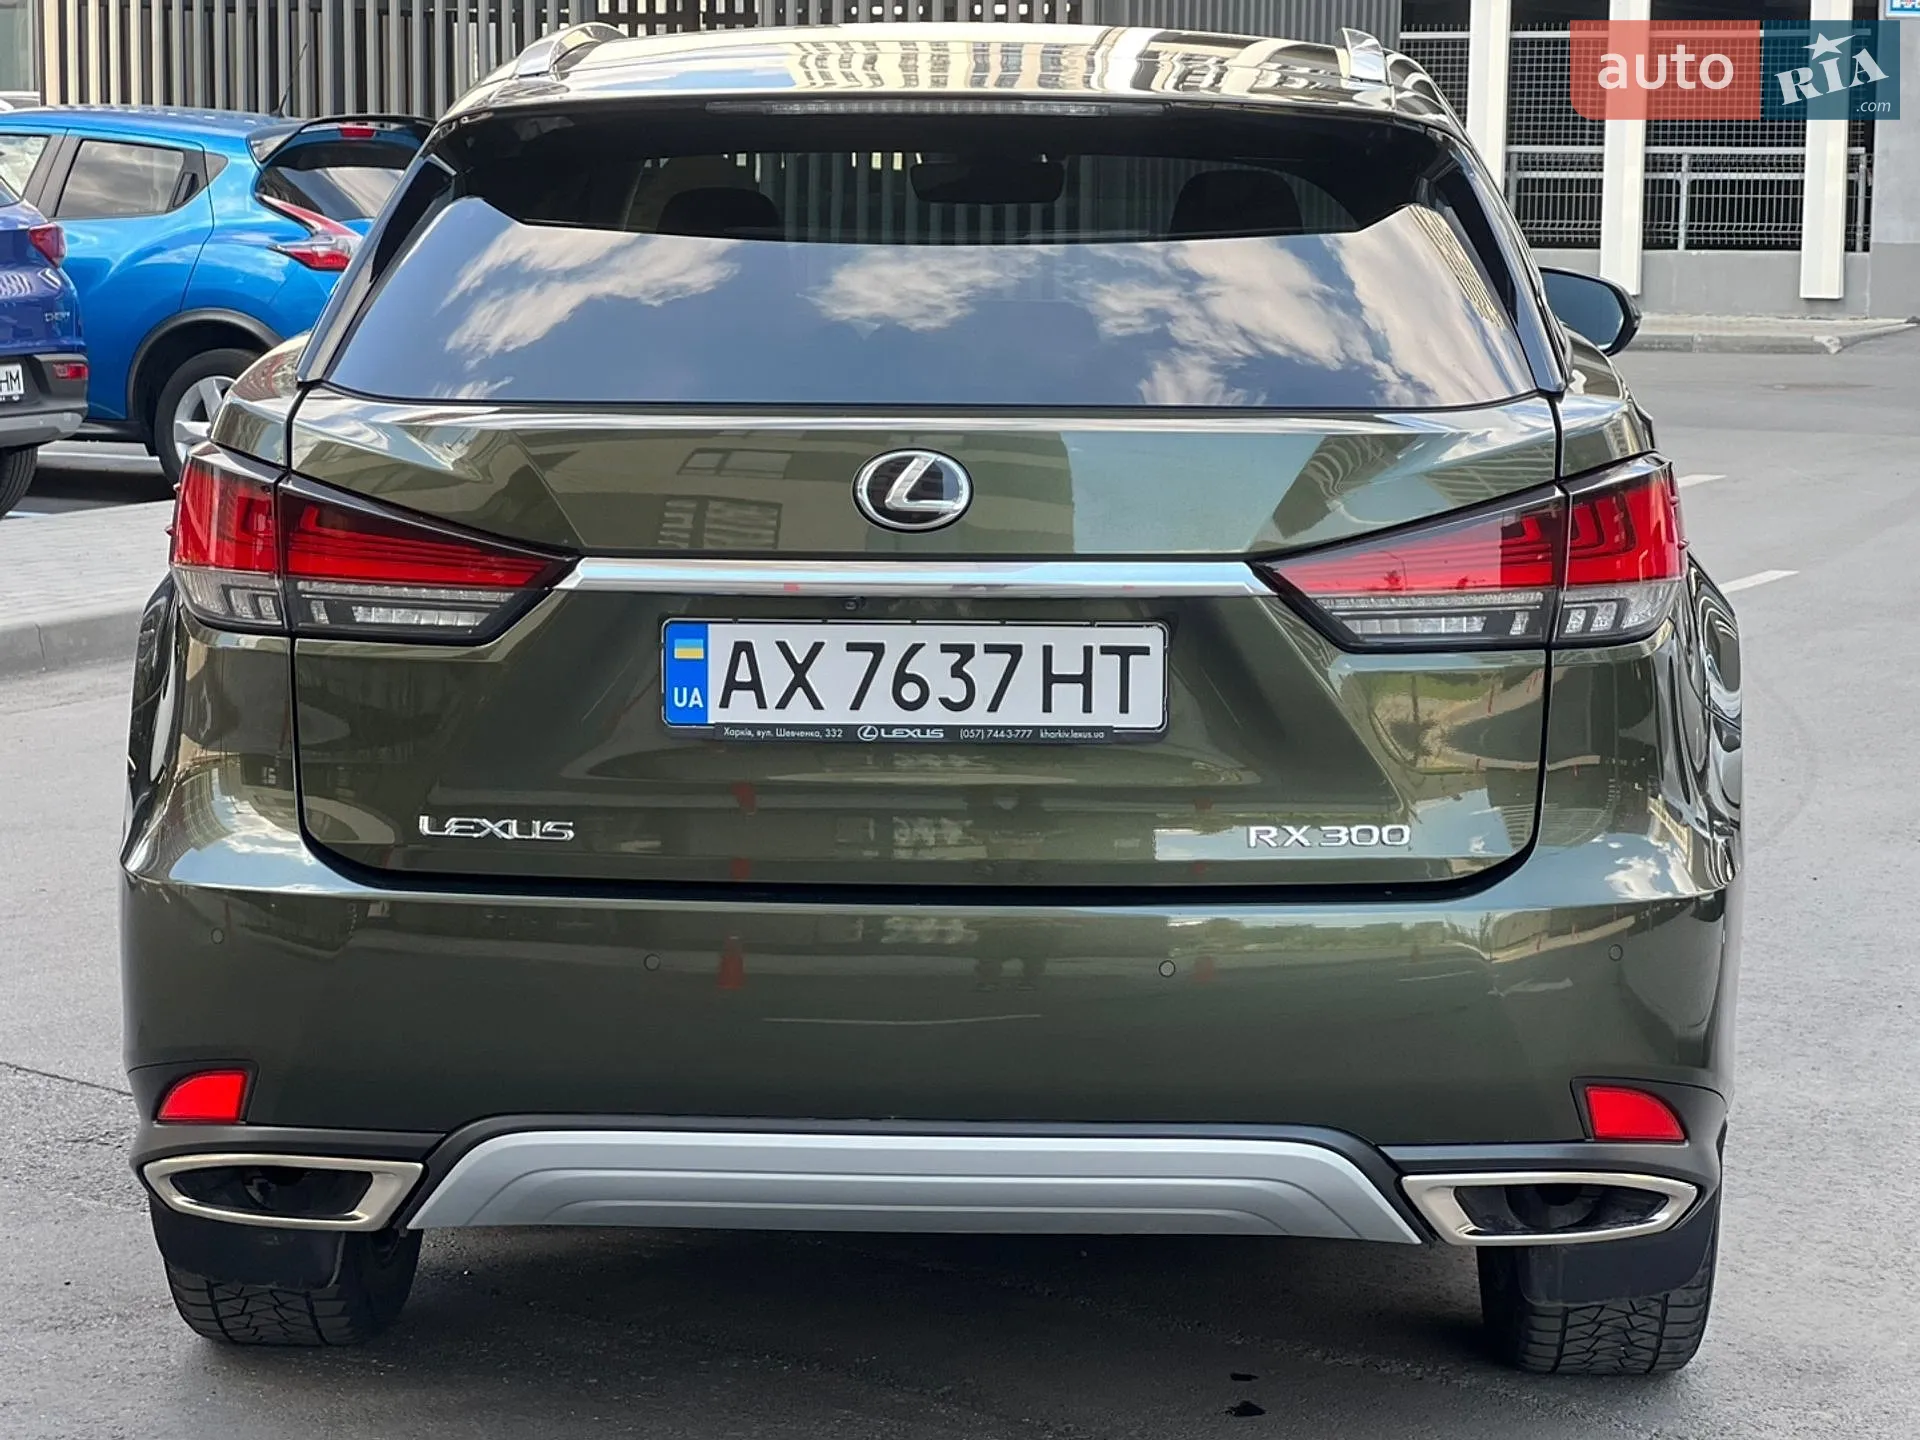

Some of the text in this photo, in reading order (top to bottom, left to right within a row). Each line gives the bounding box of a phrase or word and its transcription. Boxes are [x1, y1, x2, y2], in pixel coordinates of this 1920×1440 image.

[719, 640, 1151, 714] AX 7637 HT
[674, 687, 704, 708] UA
[825, 729, 843, 738] 332
[880, 728, 945, 738] LEXUS
[959, 729, 984, 740] (057)
[418, 815, 575, 841] LEXUS
[1248, 824, 1412, 847] RX 300
